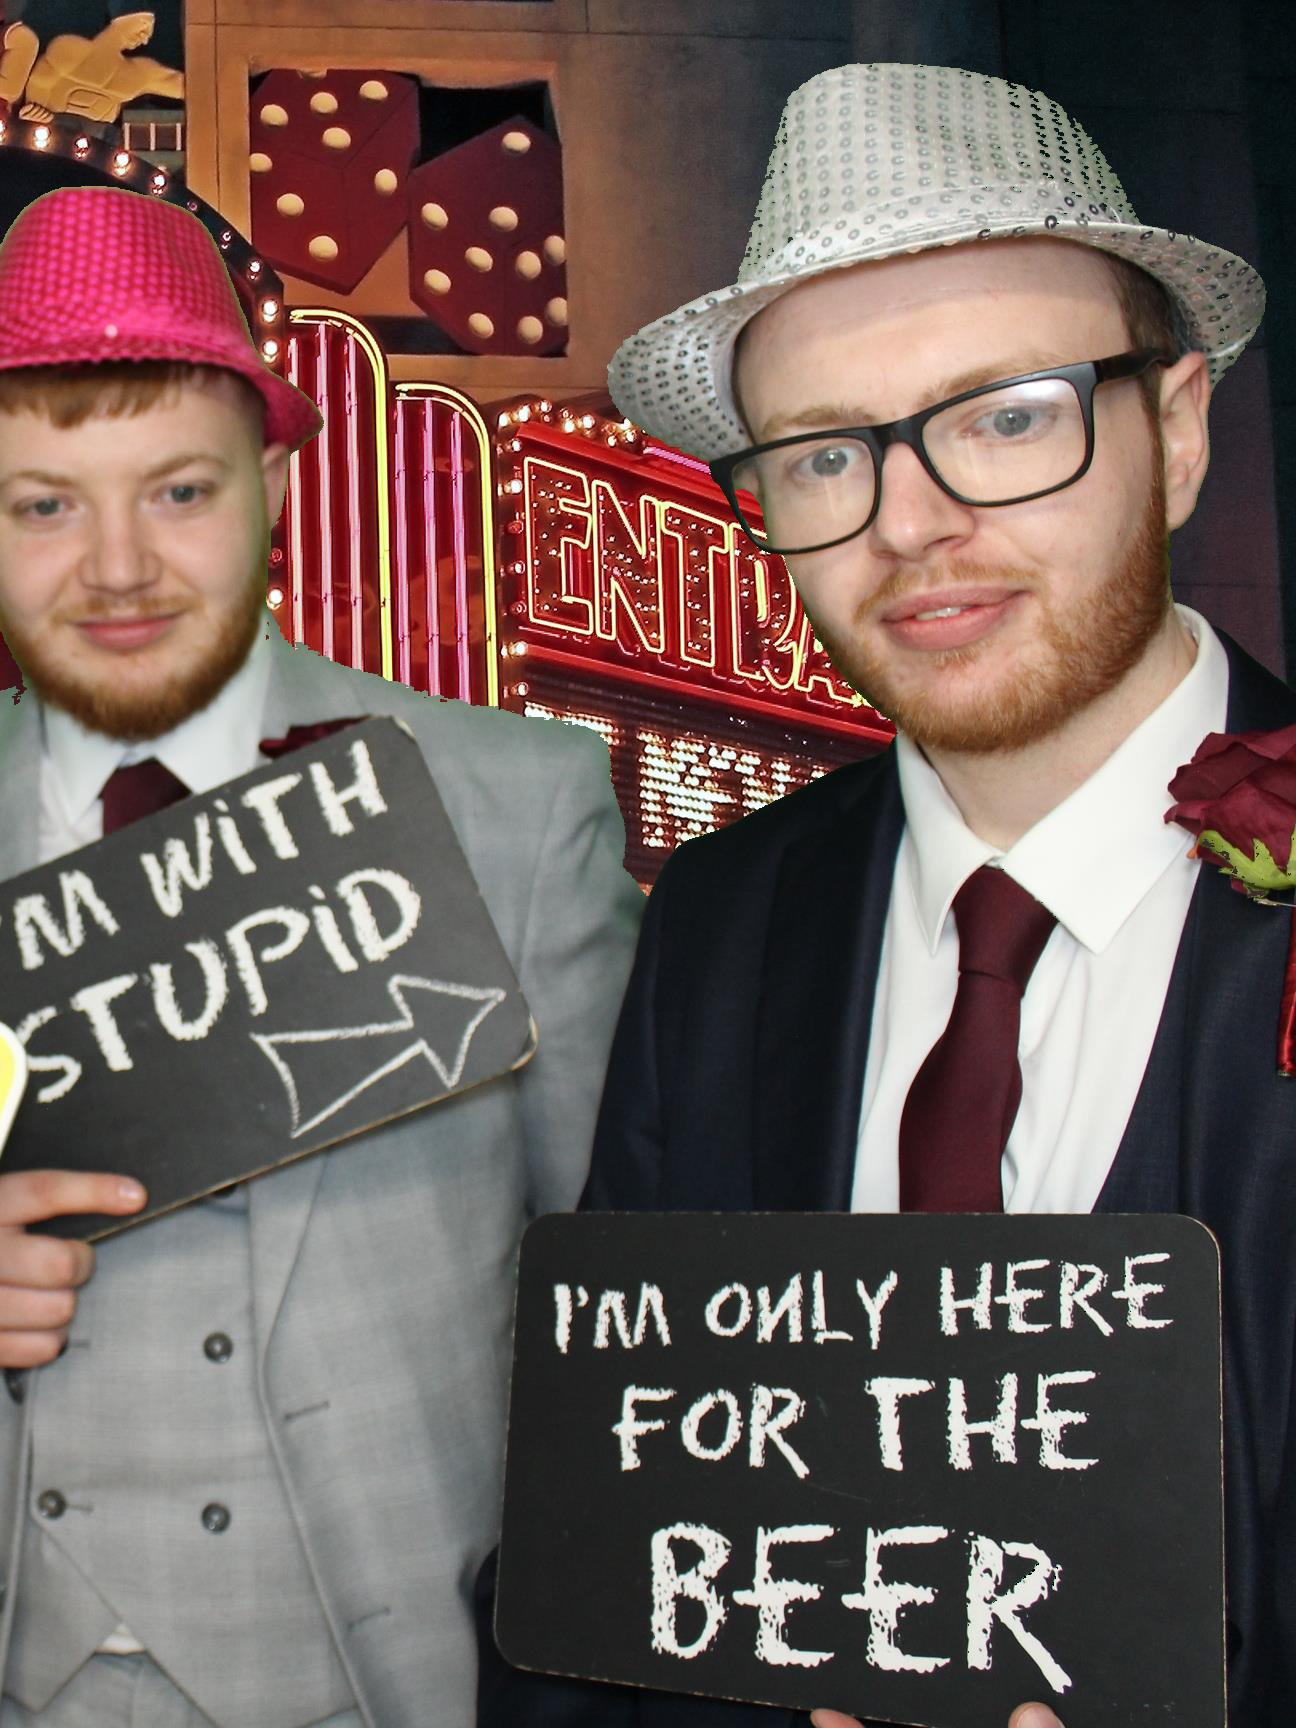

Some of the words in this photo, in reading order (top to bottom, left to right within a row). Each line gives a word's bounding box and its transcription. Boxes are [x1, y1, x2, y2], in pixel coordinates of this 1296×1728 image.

[553, 1282, 672, 1355] I'M
[704, 1269, 899, 1350] ONLY
[938, 1252, 1174, 1337] HERE
[611, 1383, 810, 1479] FOR
[864, 1370, 1101, 1472] THE
[650, 1522, 1073, 1694] BEER
